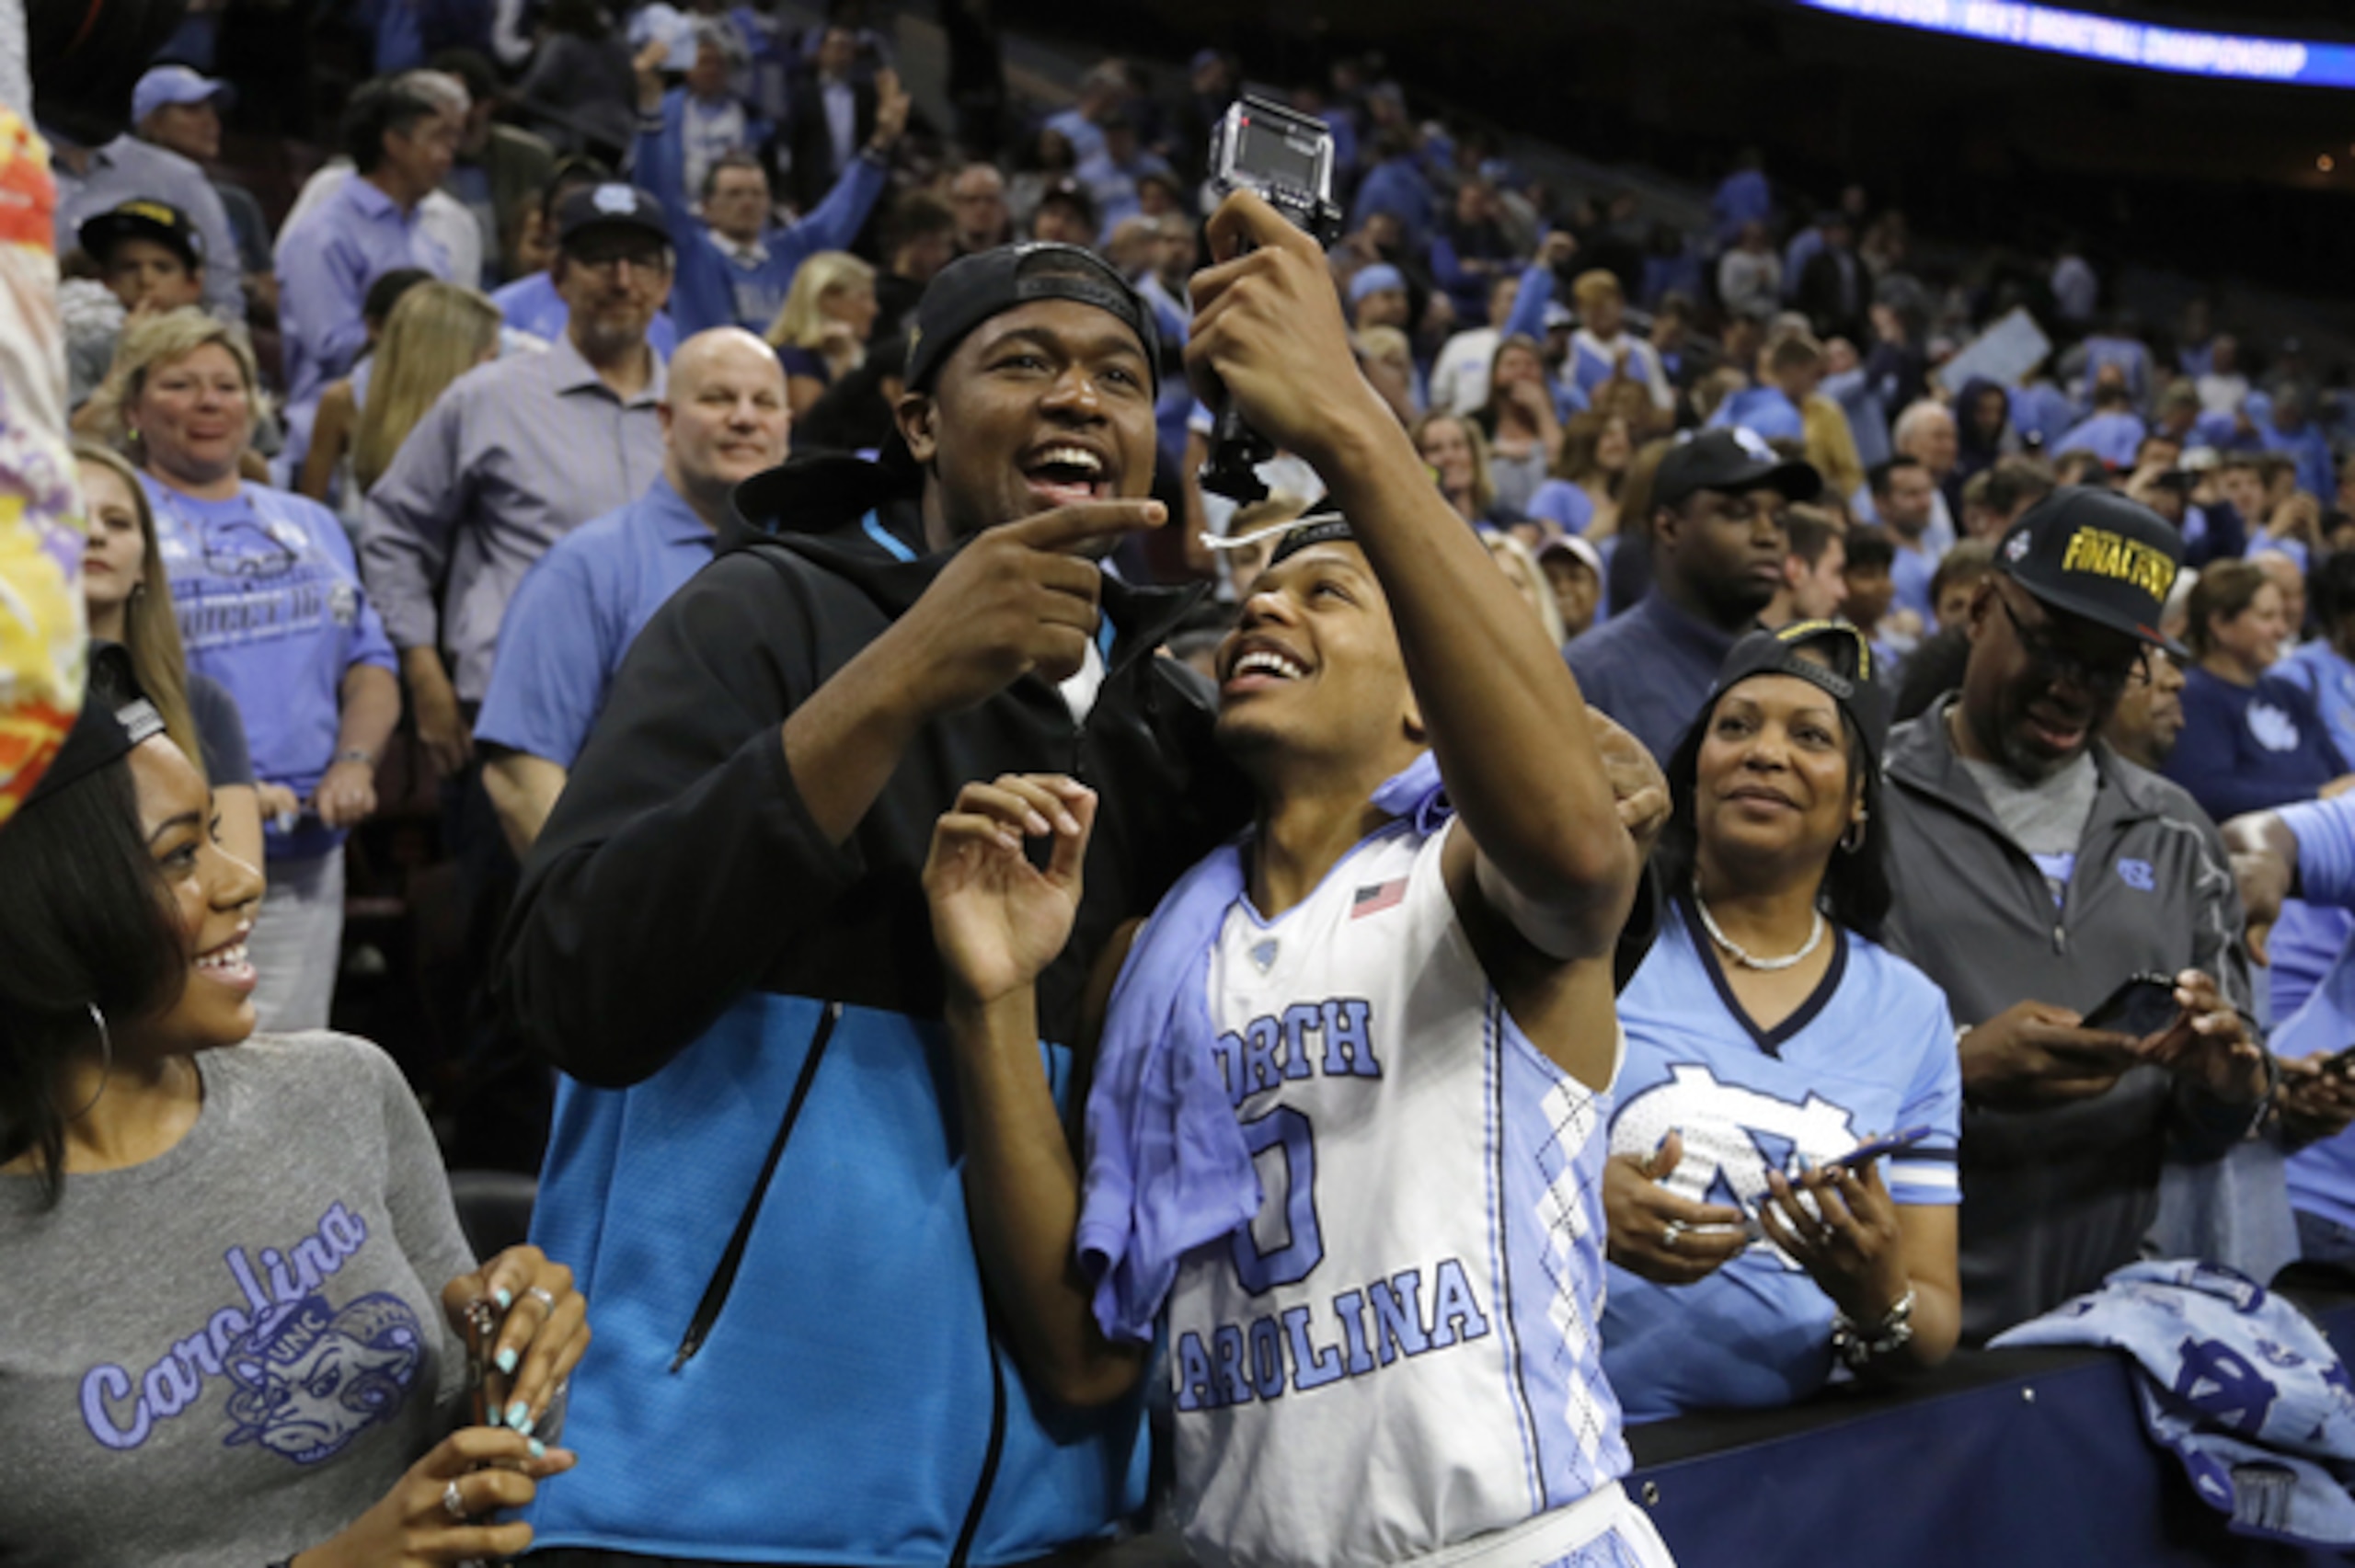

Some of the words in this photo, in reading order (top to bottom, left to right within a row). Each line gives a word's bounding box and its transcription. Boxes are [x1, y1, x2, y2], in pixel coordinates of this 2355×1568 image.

[1215, 998, 1383, 1104] ORTH
[80, 1199, 368, 1450] Carolina
[268, 1309, 327, 1360] UNC
[1177, 1257, 1490, 1412] AROLINA
